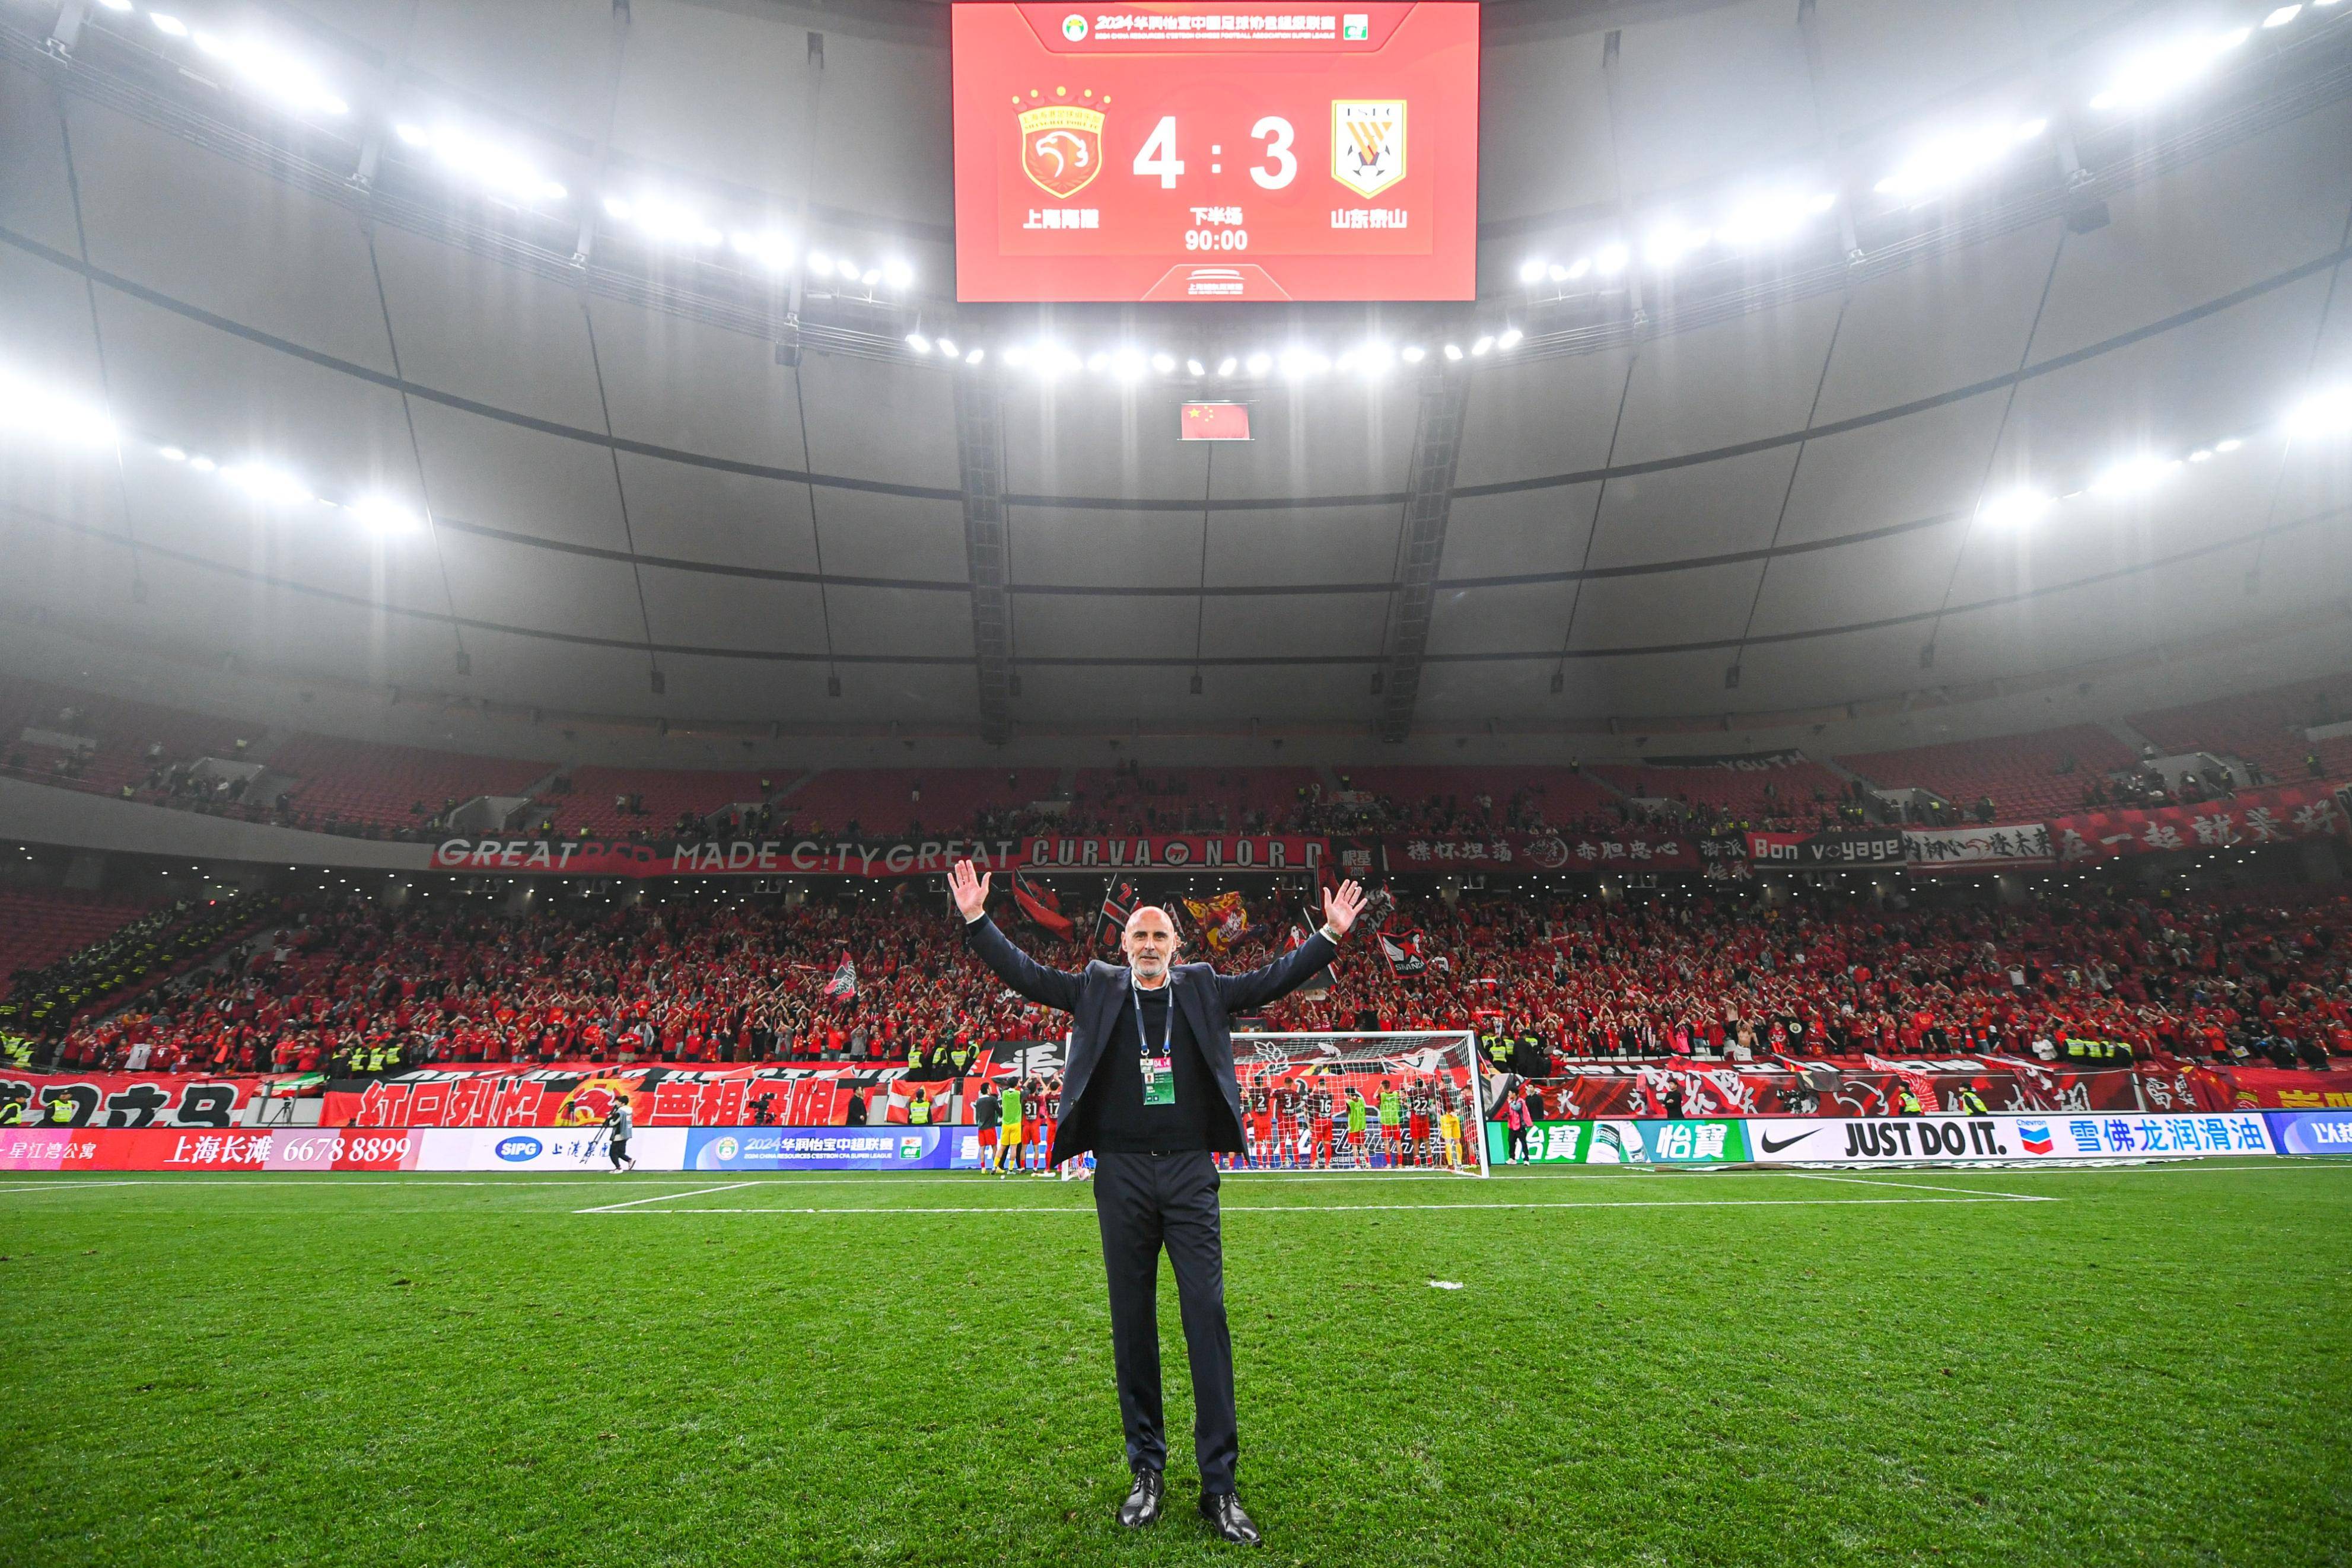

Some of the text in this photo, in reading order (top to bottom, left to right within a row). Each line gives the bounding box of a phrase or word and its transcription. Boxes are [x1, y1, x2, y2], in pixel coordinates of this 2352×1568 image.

[1133, 116, 1185, 189] 4
[1249, 116, 1297, 190] 3
[1331, 209, 1408, 229] 山东泰山
[1185, 230, 1247, 250] 90:00
[438, 839, 578, 869] GREAT
[672, 841, 777, 870] MADE
[885, 840, 1013, 872] GREAT
[1032, 840, 1323, 868] CURVA NORD
[1342, 850, 1371, 866] 根基
[1575, 840, 1679, 860] 赤胆忠心
[1754, 839, 1798, 860] Bon
[1024, 1102, 1037, 1114] 31
[1048, 1102, 1060, 1114] 17
[1258, 1097, 1265, 1108] 2
[1284, 1097, 1292, 1108] 3
[1319, 1099, 1332, 1113] 16
[1413, 1099, 1428, 1111] 22
[1656, 1124, 1727, 1159] 怡寶
[1845, 1121, 2007, 1157] JUST DO IT.
[2070, 1117, 2267, 1152] 雪佛龙润滑油
[8, 1142, 97, 1160] 星江湾公寓
[163, 1135, 411, 1164] 上海长滩 6678 8899
[501, 1142, 537, 1156] SIPG
